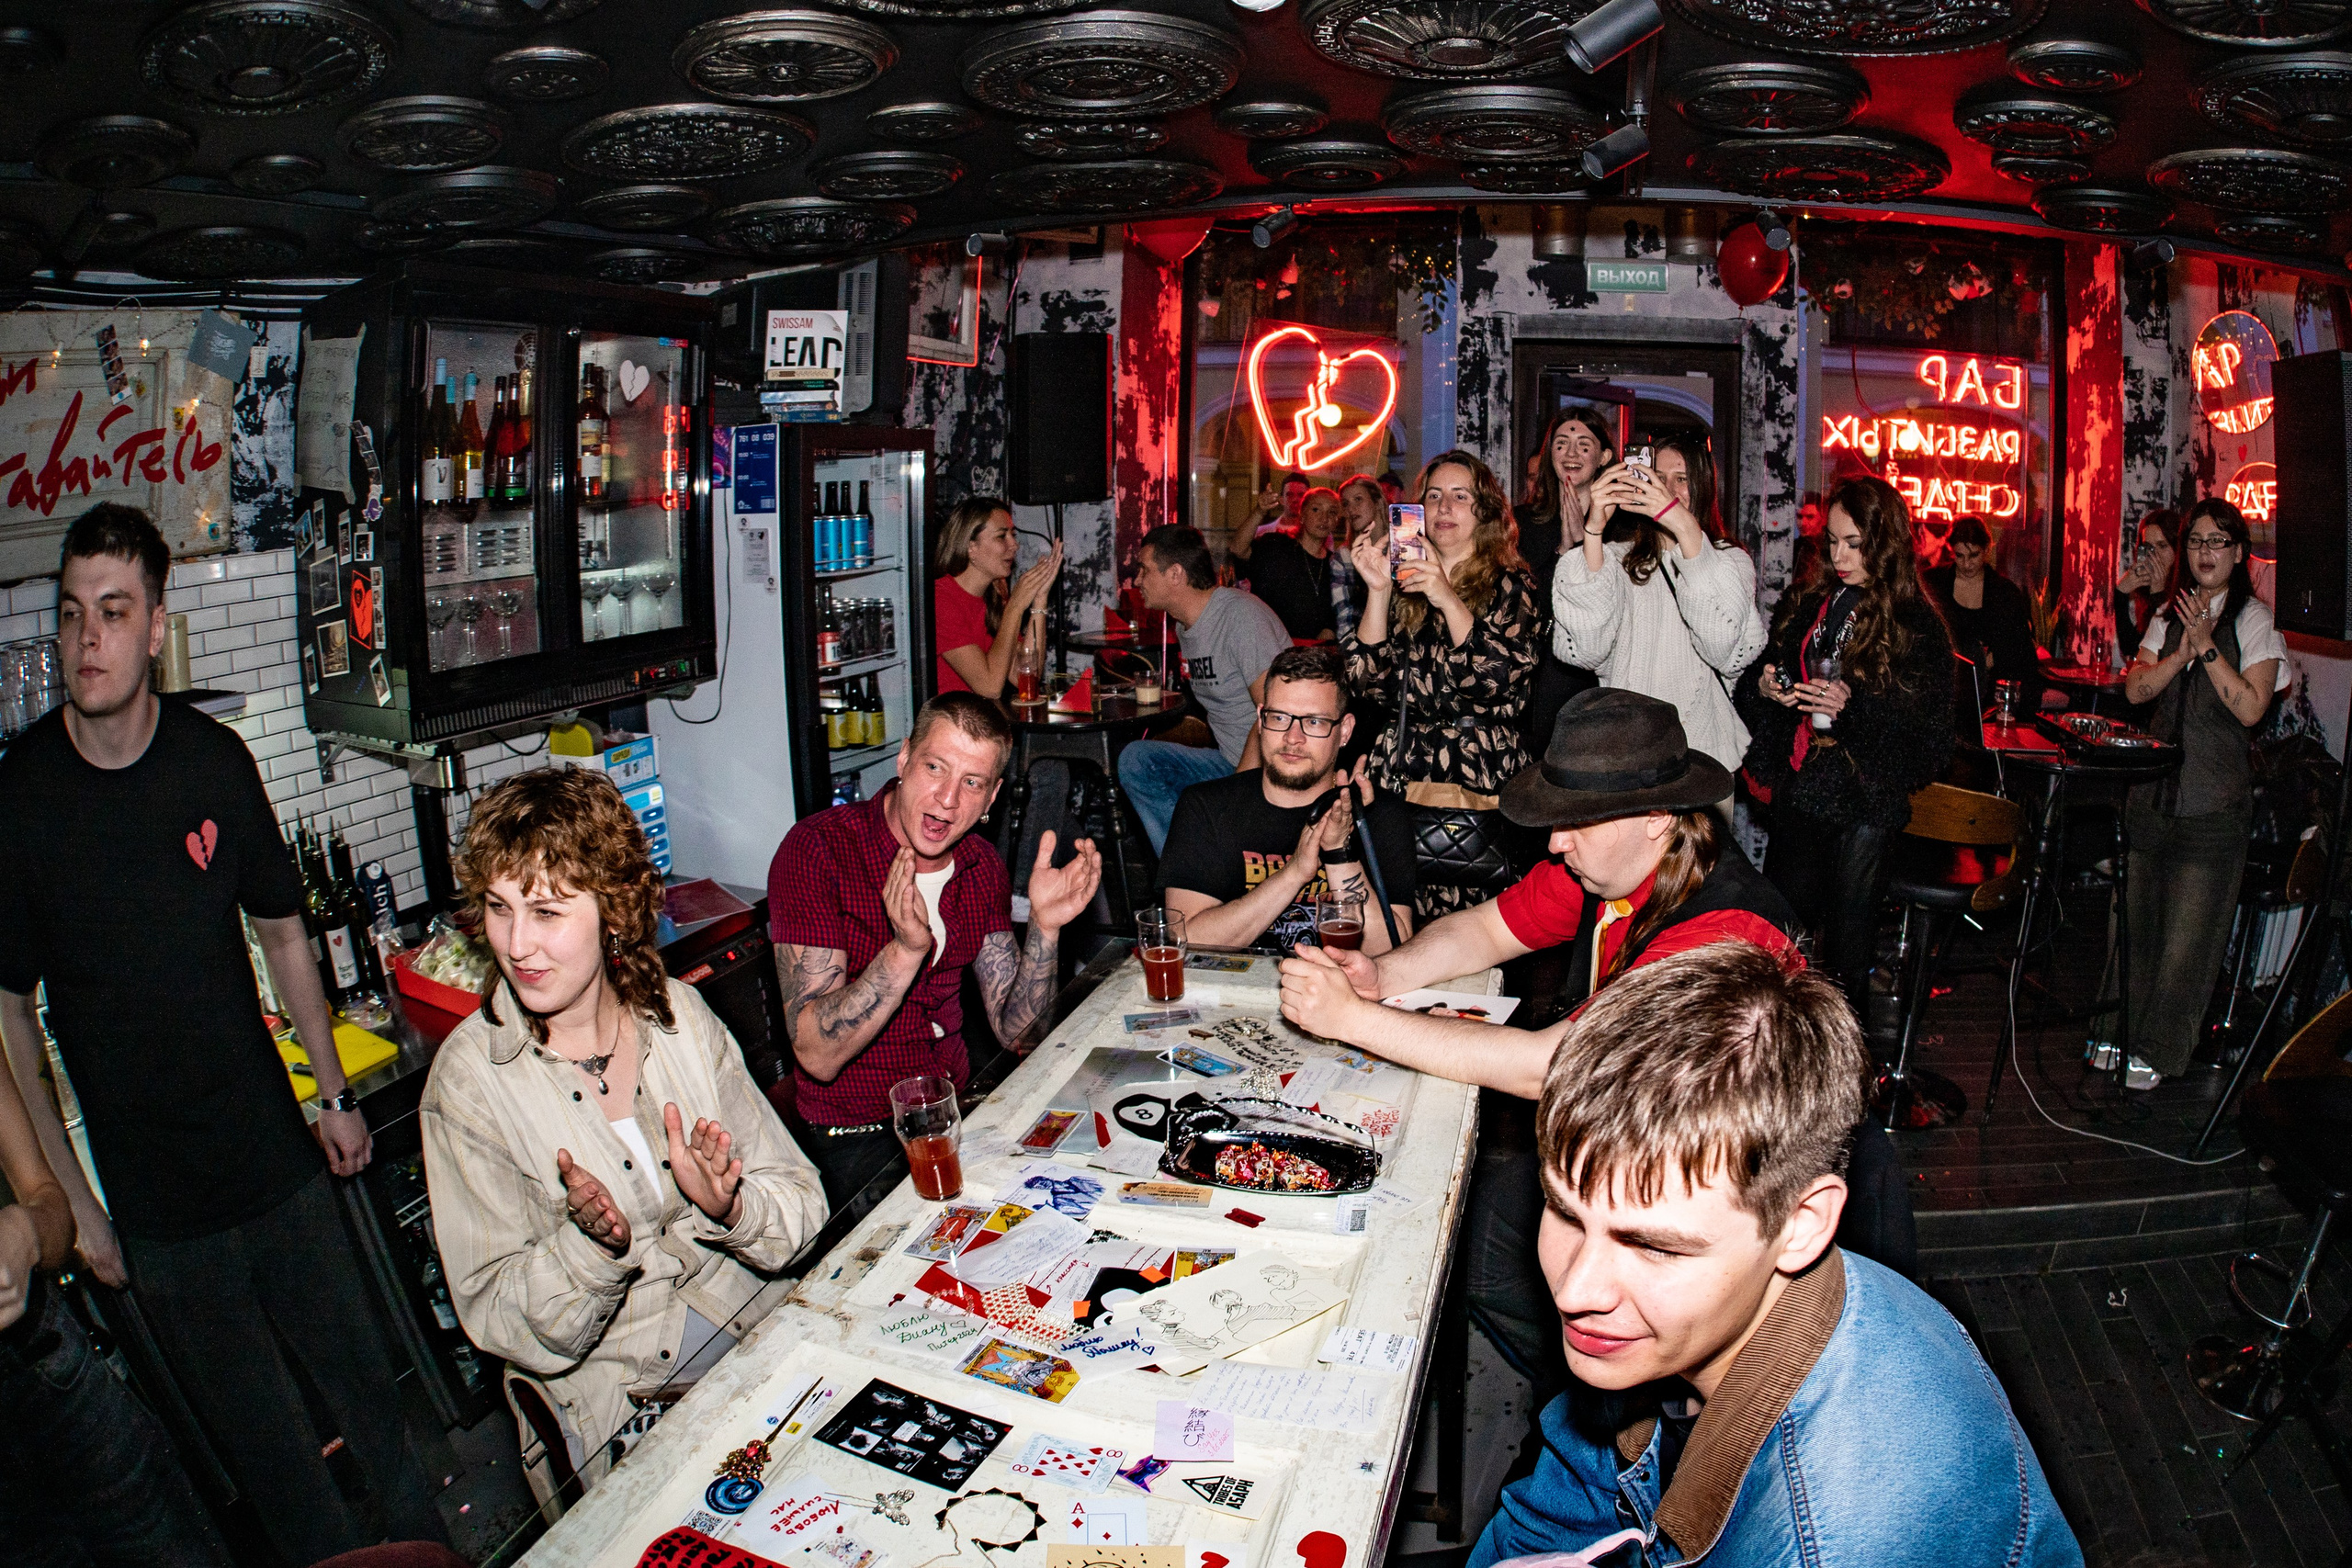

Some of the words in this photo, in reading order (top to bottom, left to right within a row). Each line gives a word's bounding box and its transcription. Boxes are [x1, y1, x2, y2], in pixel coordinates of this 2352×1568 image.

[1597, 269, 1660, 287] ВЫХОД
[772, 317, 814, 329] SWISSAM
[374, 883, 390, 916] ich
[896, 1321, 948, 1344] Диану
[1356, 1328, 1367, 1343] SEAT
[1213, 1483, 1234, 1506] TRIBES
[1226, 1475, 1238, 1485] OF
[1226, 1479, 1255, 1510] ASAPH
[1071, 1502, 1086, 1515] A
